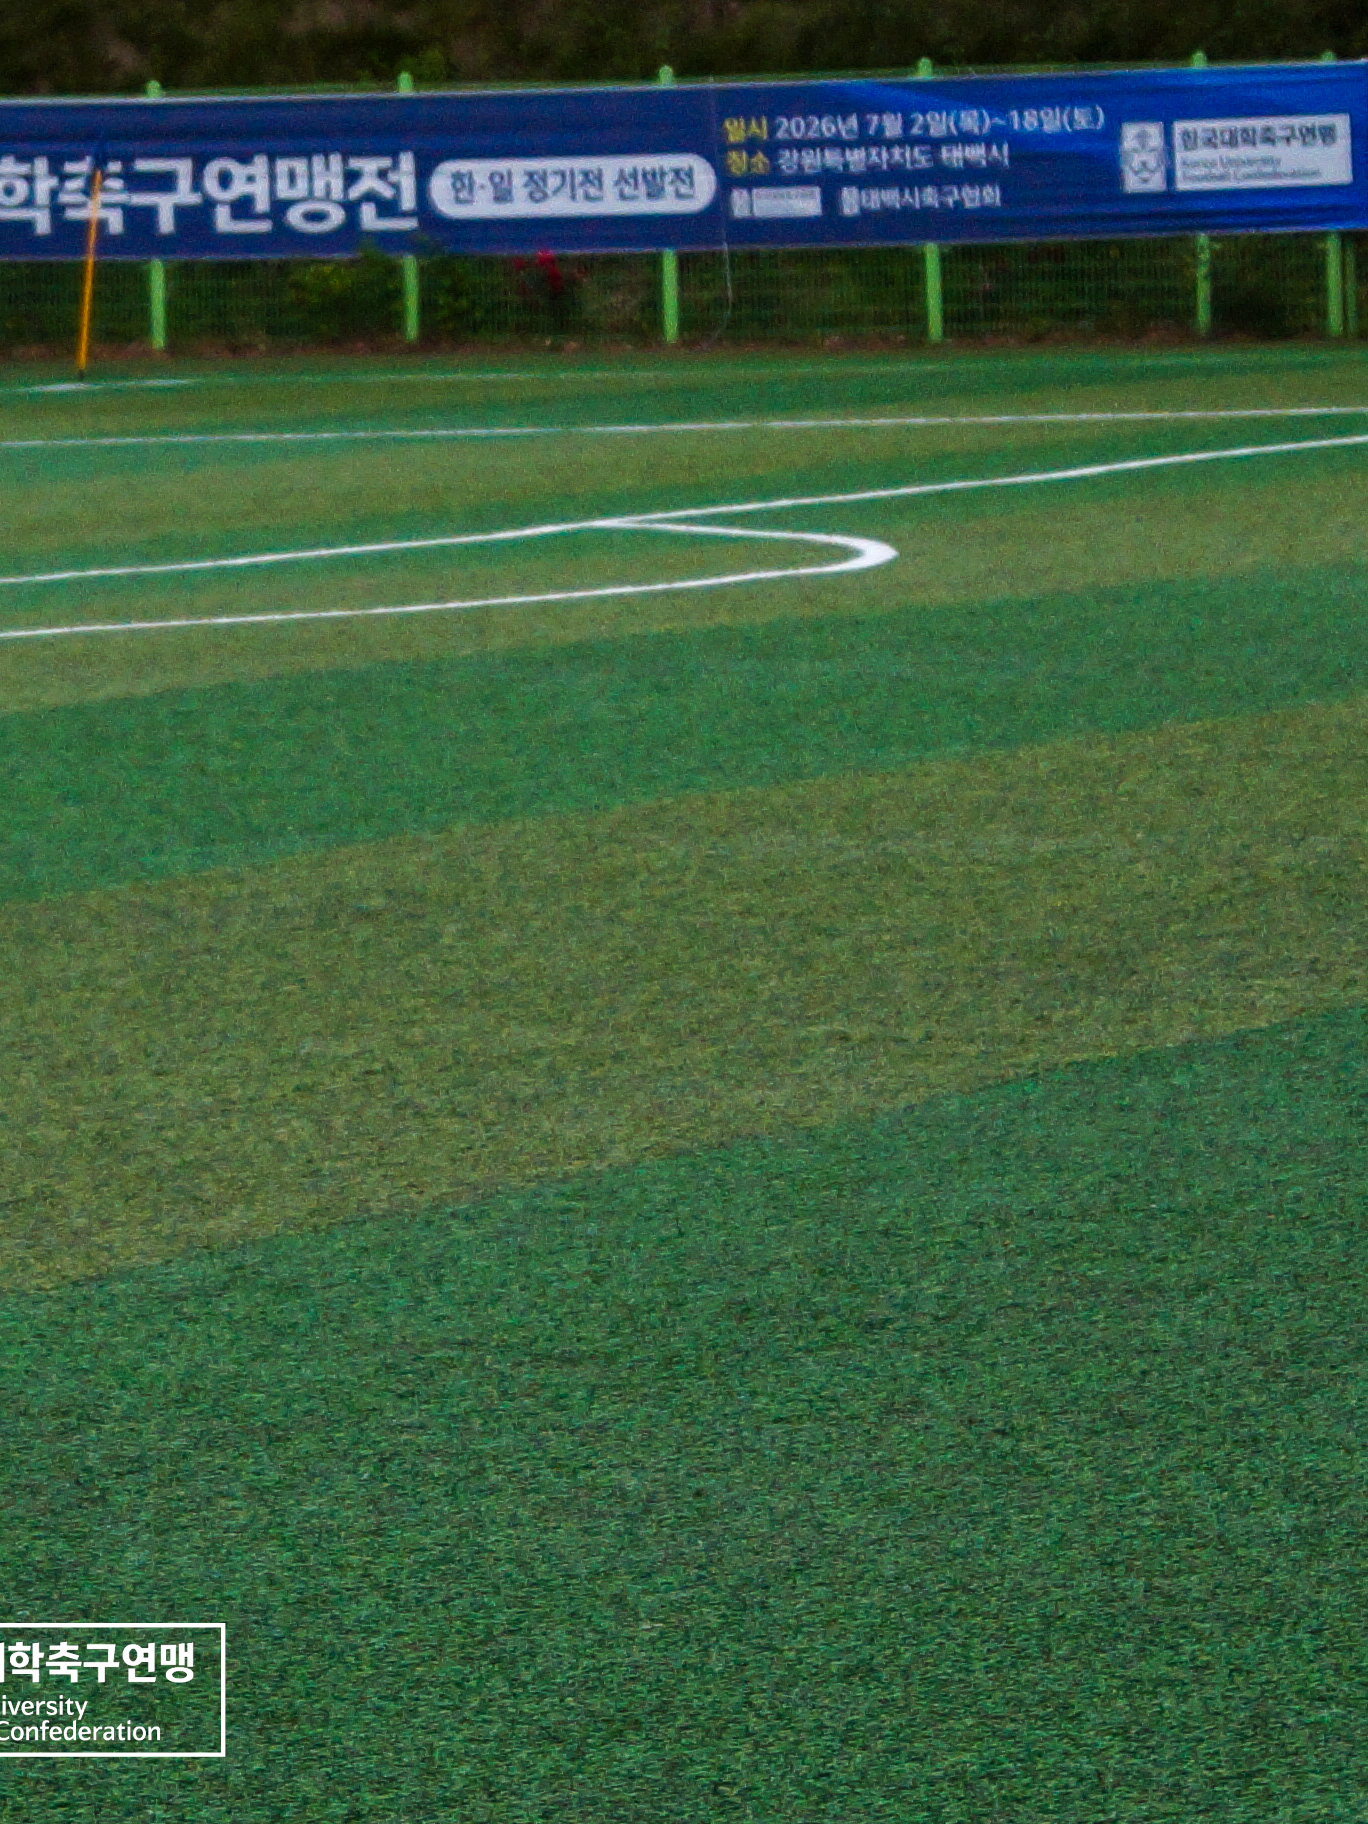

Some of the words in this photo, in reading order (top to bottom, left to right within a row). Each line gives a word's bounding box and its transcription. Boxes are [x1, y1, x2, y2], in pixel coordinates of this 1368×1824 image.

[775, 112, 859, 140] 2026년
[521, 166, 605, 204] 정기전
[612, 163, 695, 201] 선발전
